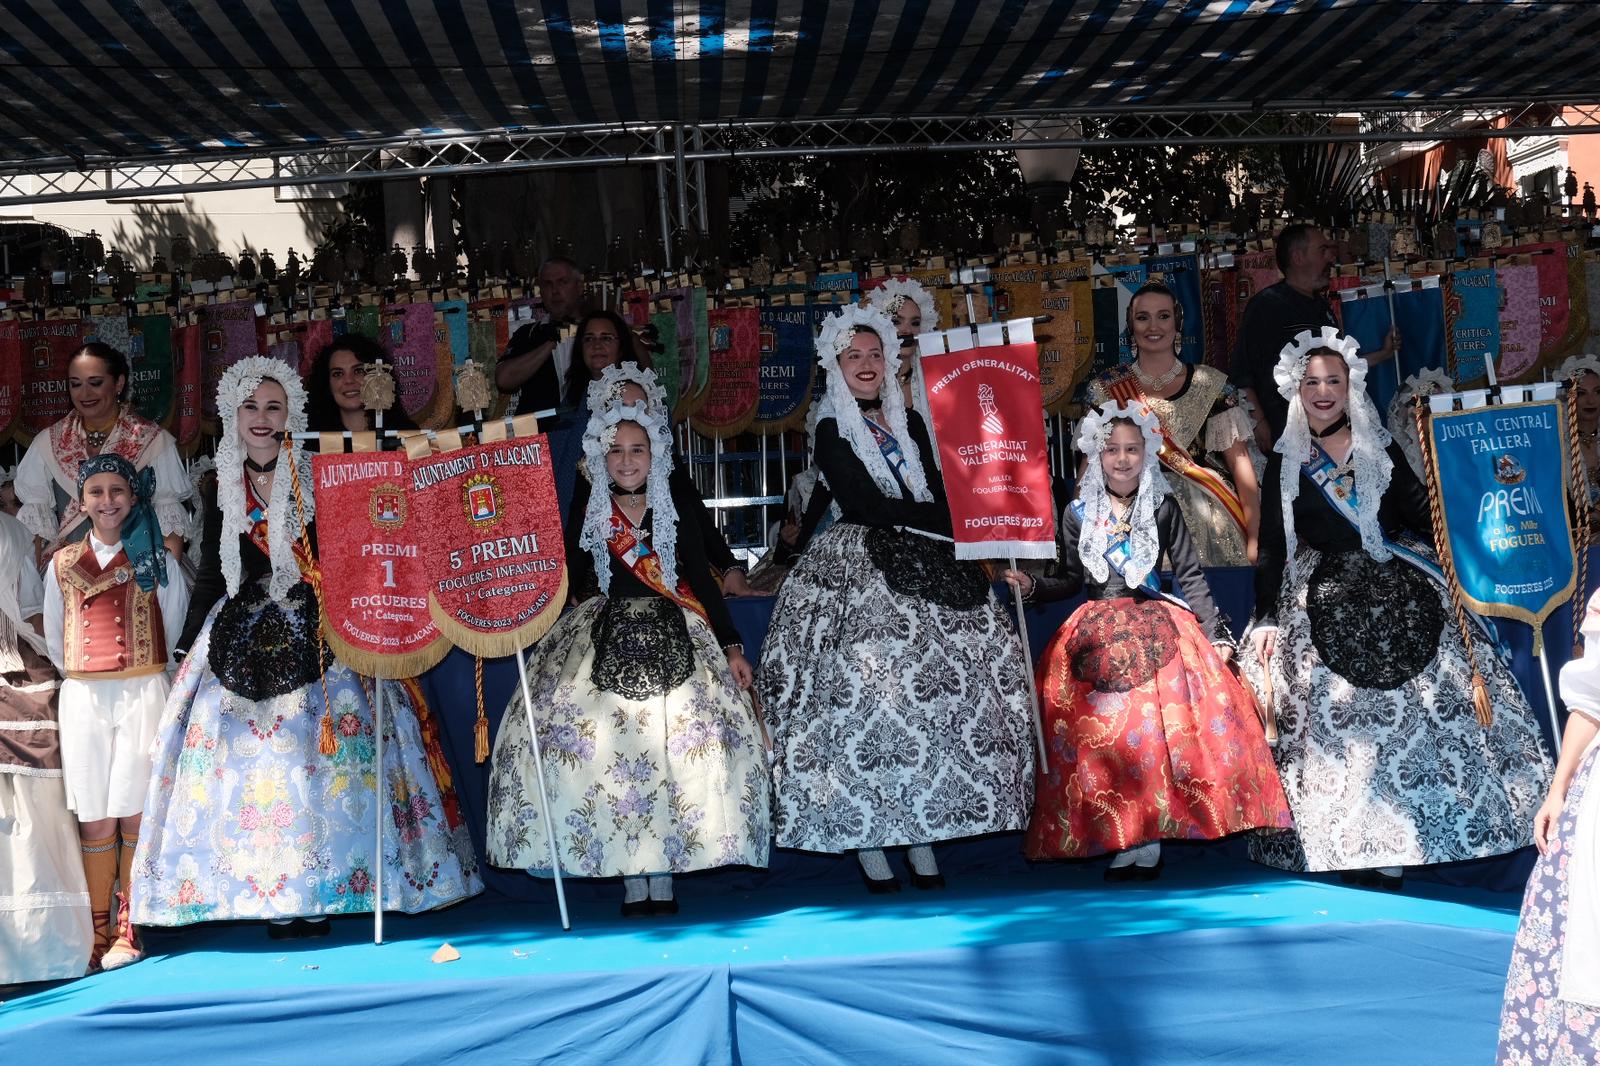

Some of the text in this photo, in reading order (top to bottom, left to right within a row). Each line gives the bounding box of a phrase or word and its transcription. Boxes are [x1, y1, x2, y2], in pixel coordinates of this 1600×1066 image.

[132, 370, 161, 381] REMI
[760, 365, 795, 378] REMI
[931, 369, 961, 394] PREMI
[962, 359, 1035, 382] GENERALITAT
[31, 379, 67, 393] PREM
[760, 382, 790, 390] UERES
[1441, 412, 1552, 442] JUNTA CENTRAL
[958, 440, 1028, 456] GENERALITAT
[1470, 433, 1532, 455] FALLERA
[960, 451, 1028, 467] VALENCIANA
[320, 461, 389, 489] AJUNTAMENT
[412, 454, 476, 491] AJUNTAMENT
[965, 516, 1043, 529] FOGUERES 2023
[361, 544, 418, 557] PREMI
[471, 534, 540, 565] PREMI
[1490, 533, 1546, 552] FOGUERA
[380, 560, 397, 587] 1
[438, 558, 558, 593] FOGUERES INFANTILS
[1494, 582, 1544, 595] FOGUERES
[351, 596, 428, 609] FOGUERES
[456, 592, 550, 628] FOGUERES 2023 ALACANT
[342, 619, 381, 644] FOGUERES
[404, 620, 438, 645] ALACANT
